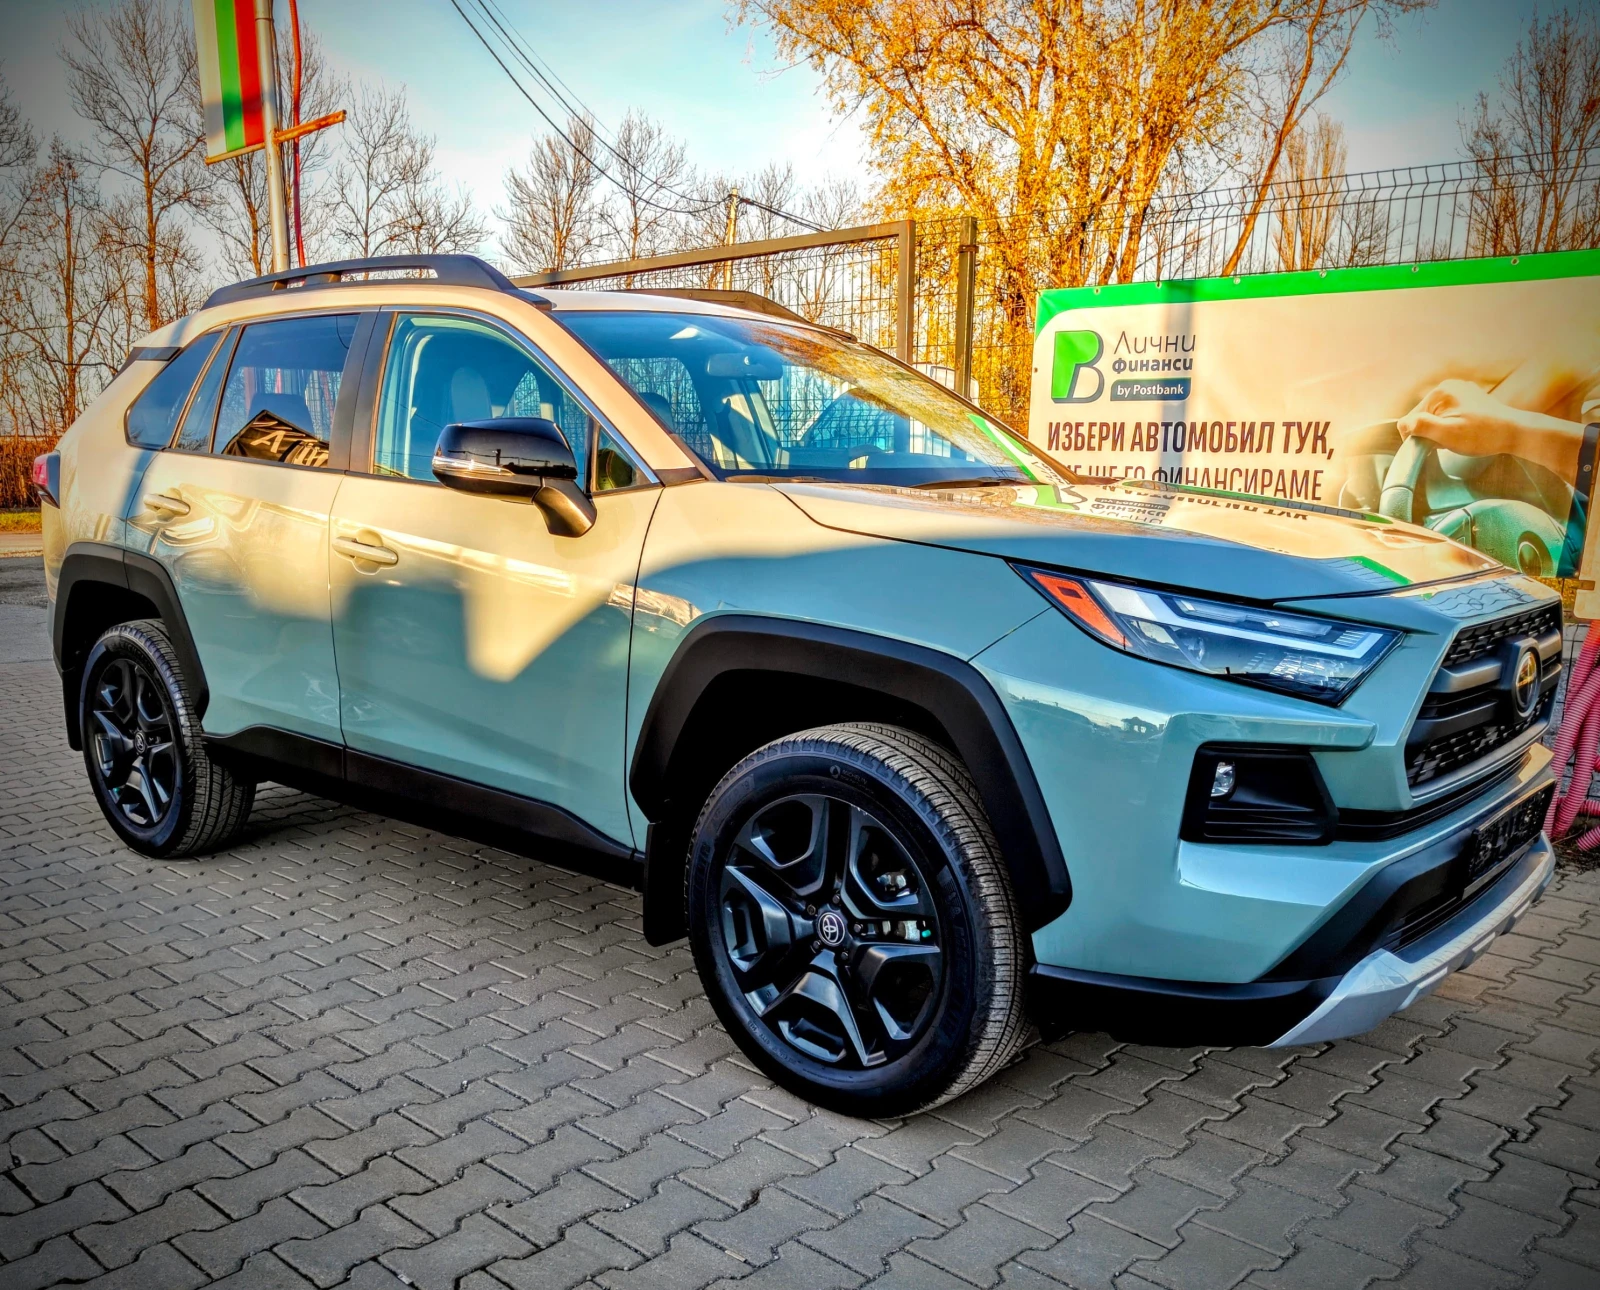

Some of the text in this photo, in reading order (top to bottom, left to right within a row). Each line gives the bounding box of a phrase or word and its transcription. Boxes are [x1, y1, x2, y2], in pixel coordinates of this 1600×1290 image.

[1114, 331, 1196, 354] Лични
[1112, 357, 1193, 374] Финанси
[1117, 384, 1184, 397] by Postbank
[1047, 421, 1334, 460] ИЗБЕРИ АВТОМОБИЛ ТУК,
[1152, 466, 1324, 501] ФИНАНСИРАМЕ
